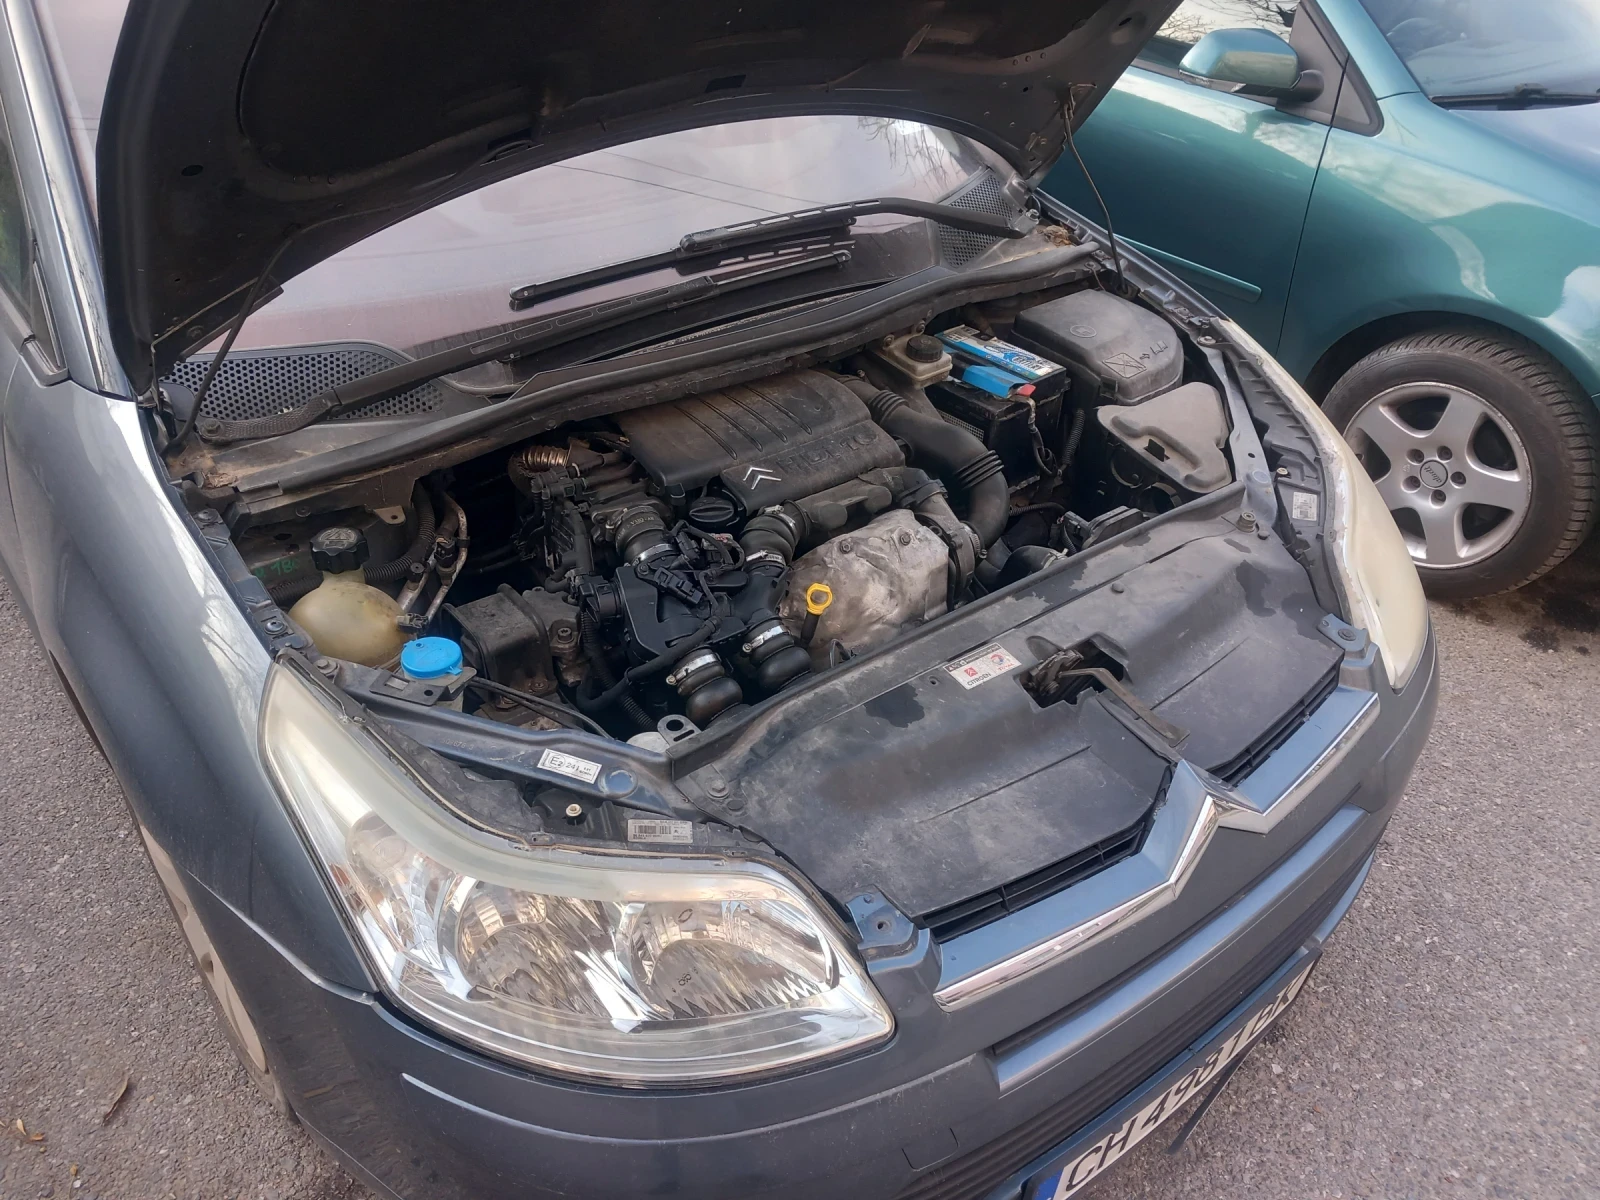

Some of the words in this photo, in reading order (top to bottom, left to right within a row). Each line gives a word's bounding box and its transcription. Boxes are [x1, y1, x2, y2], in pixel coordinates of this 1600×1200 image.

[1065, 1115, 1138, 1191] CH
[1141, 1024, 1247, 1130] 4981
[1246, 968, 1306, 1041] BK
